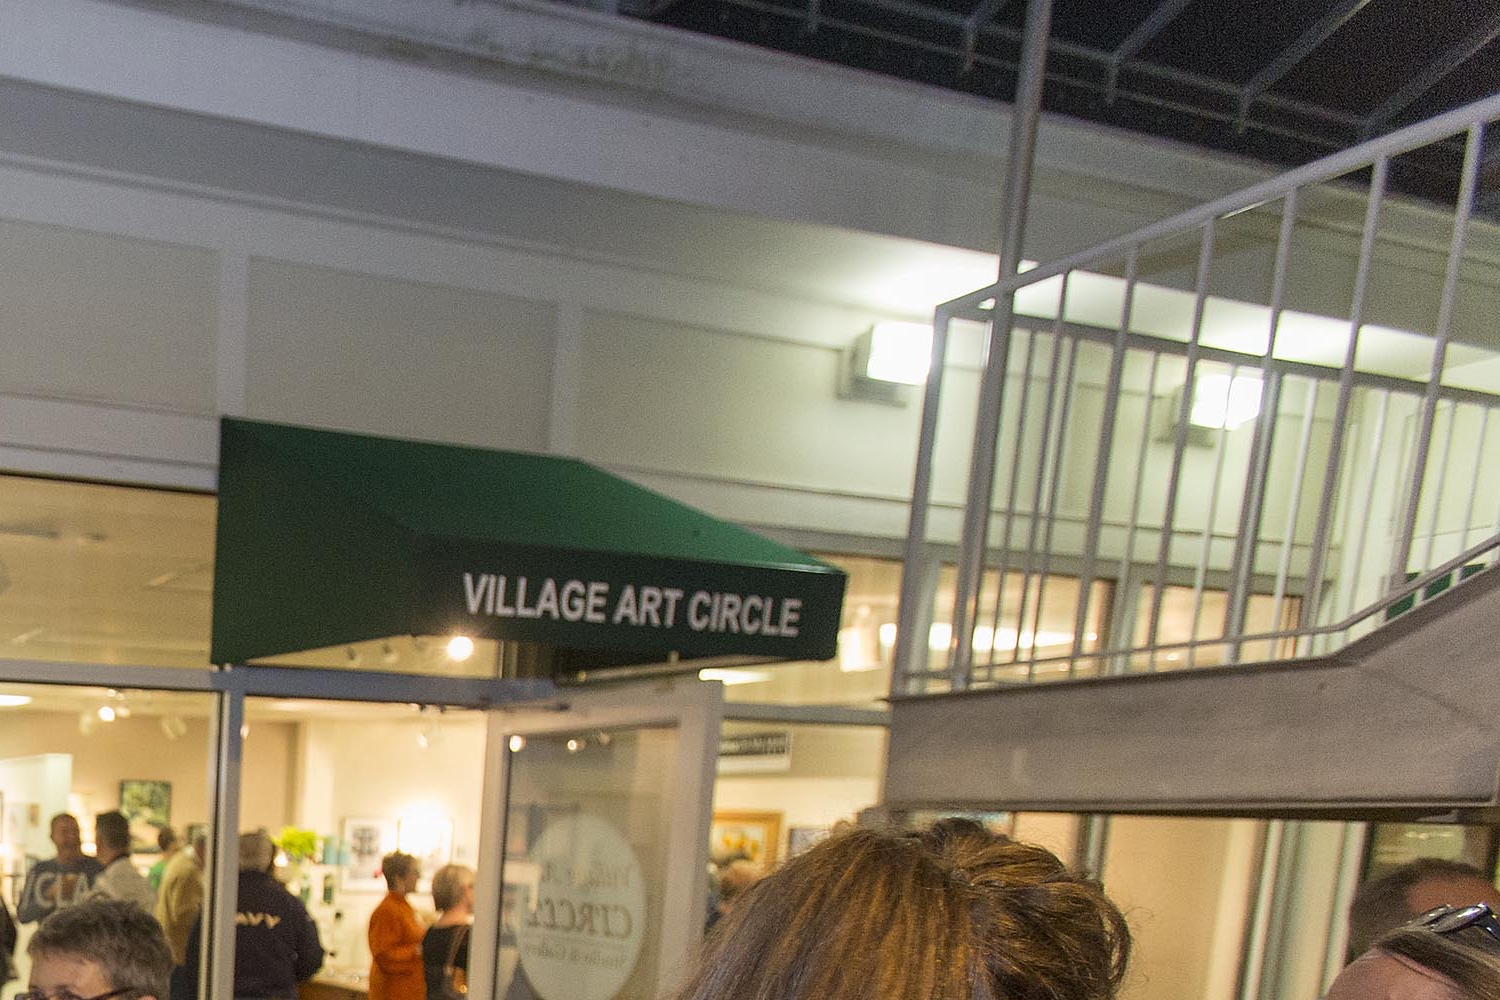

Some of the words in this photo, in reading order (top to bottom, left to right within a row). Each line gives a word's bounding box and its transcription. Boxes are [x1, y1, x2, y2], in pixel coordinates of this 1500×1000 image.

[463, 572, 609, 622] VILLAGE
[612, 584, 684, 628] ART
[687, 589, 802, 637] CIRCLE
[235, 911, 281, 929] AVY
